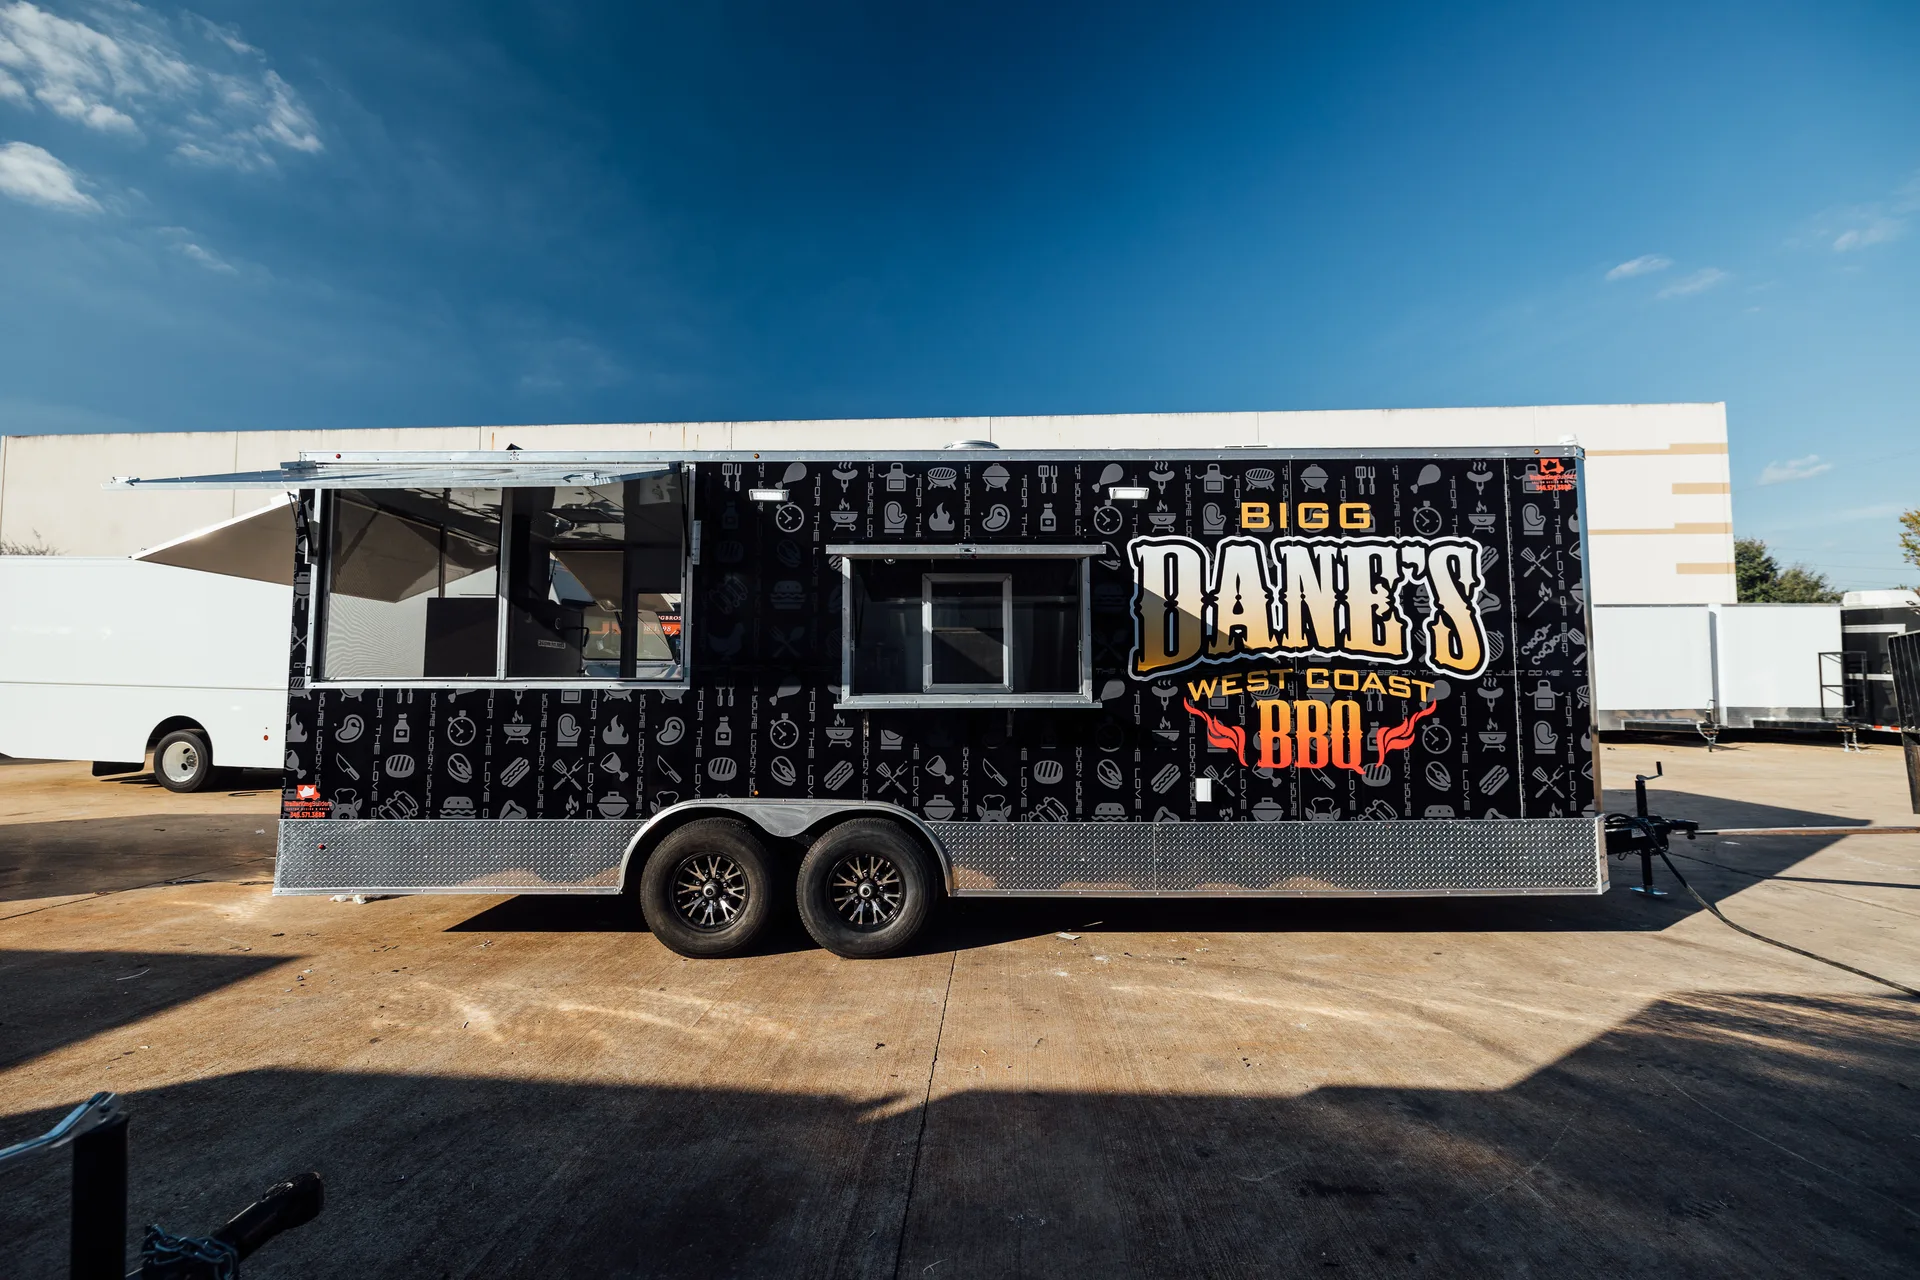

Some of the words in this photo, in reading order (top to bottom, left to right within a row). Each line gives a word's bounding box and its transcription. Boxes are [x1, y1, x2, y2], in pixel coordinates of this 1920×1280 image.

[1242, 502, 1370, 529] BIGG
[1557, 550, 1565, 590] LOVE
[1128, 536, 1490, 680] DANE'S
[1560, 596, 1567, 616] OF
[1187, 668, 1294, 702] WEST
[1306, 669, 1436, 702] COAST
[374, 724, 382, 755] THE
[1257, 700, 1366, 775] BBQ
[483, 762, 491, 802] LOVE
